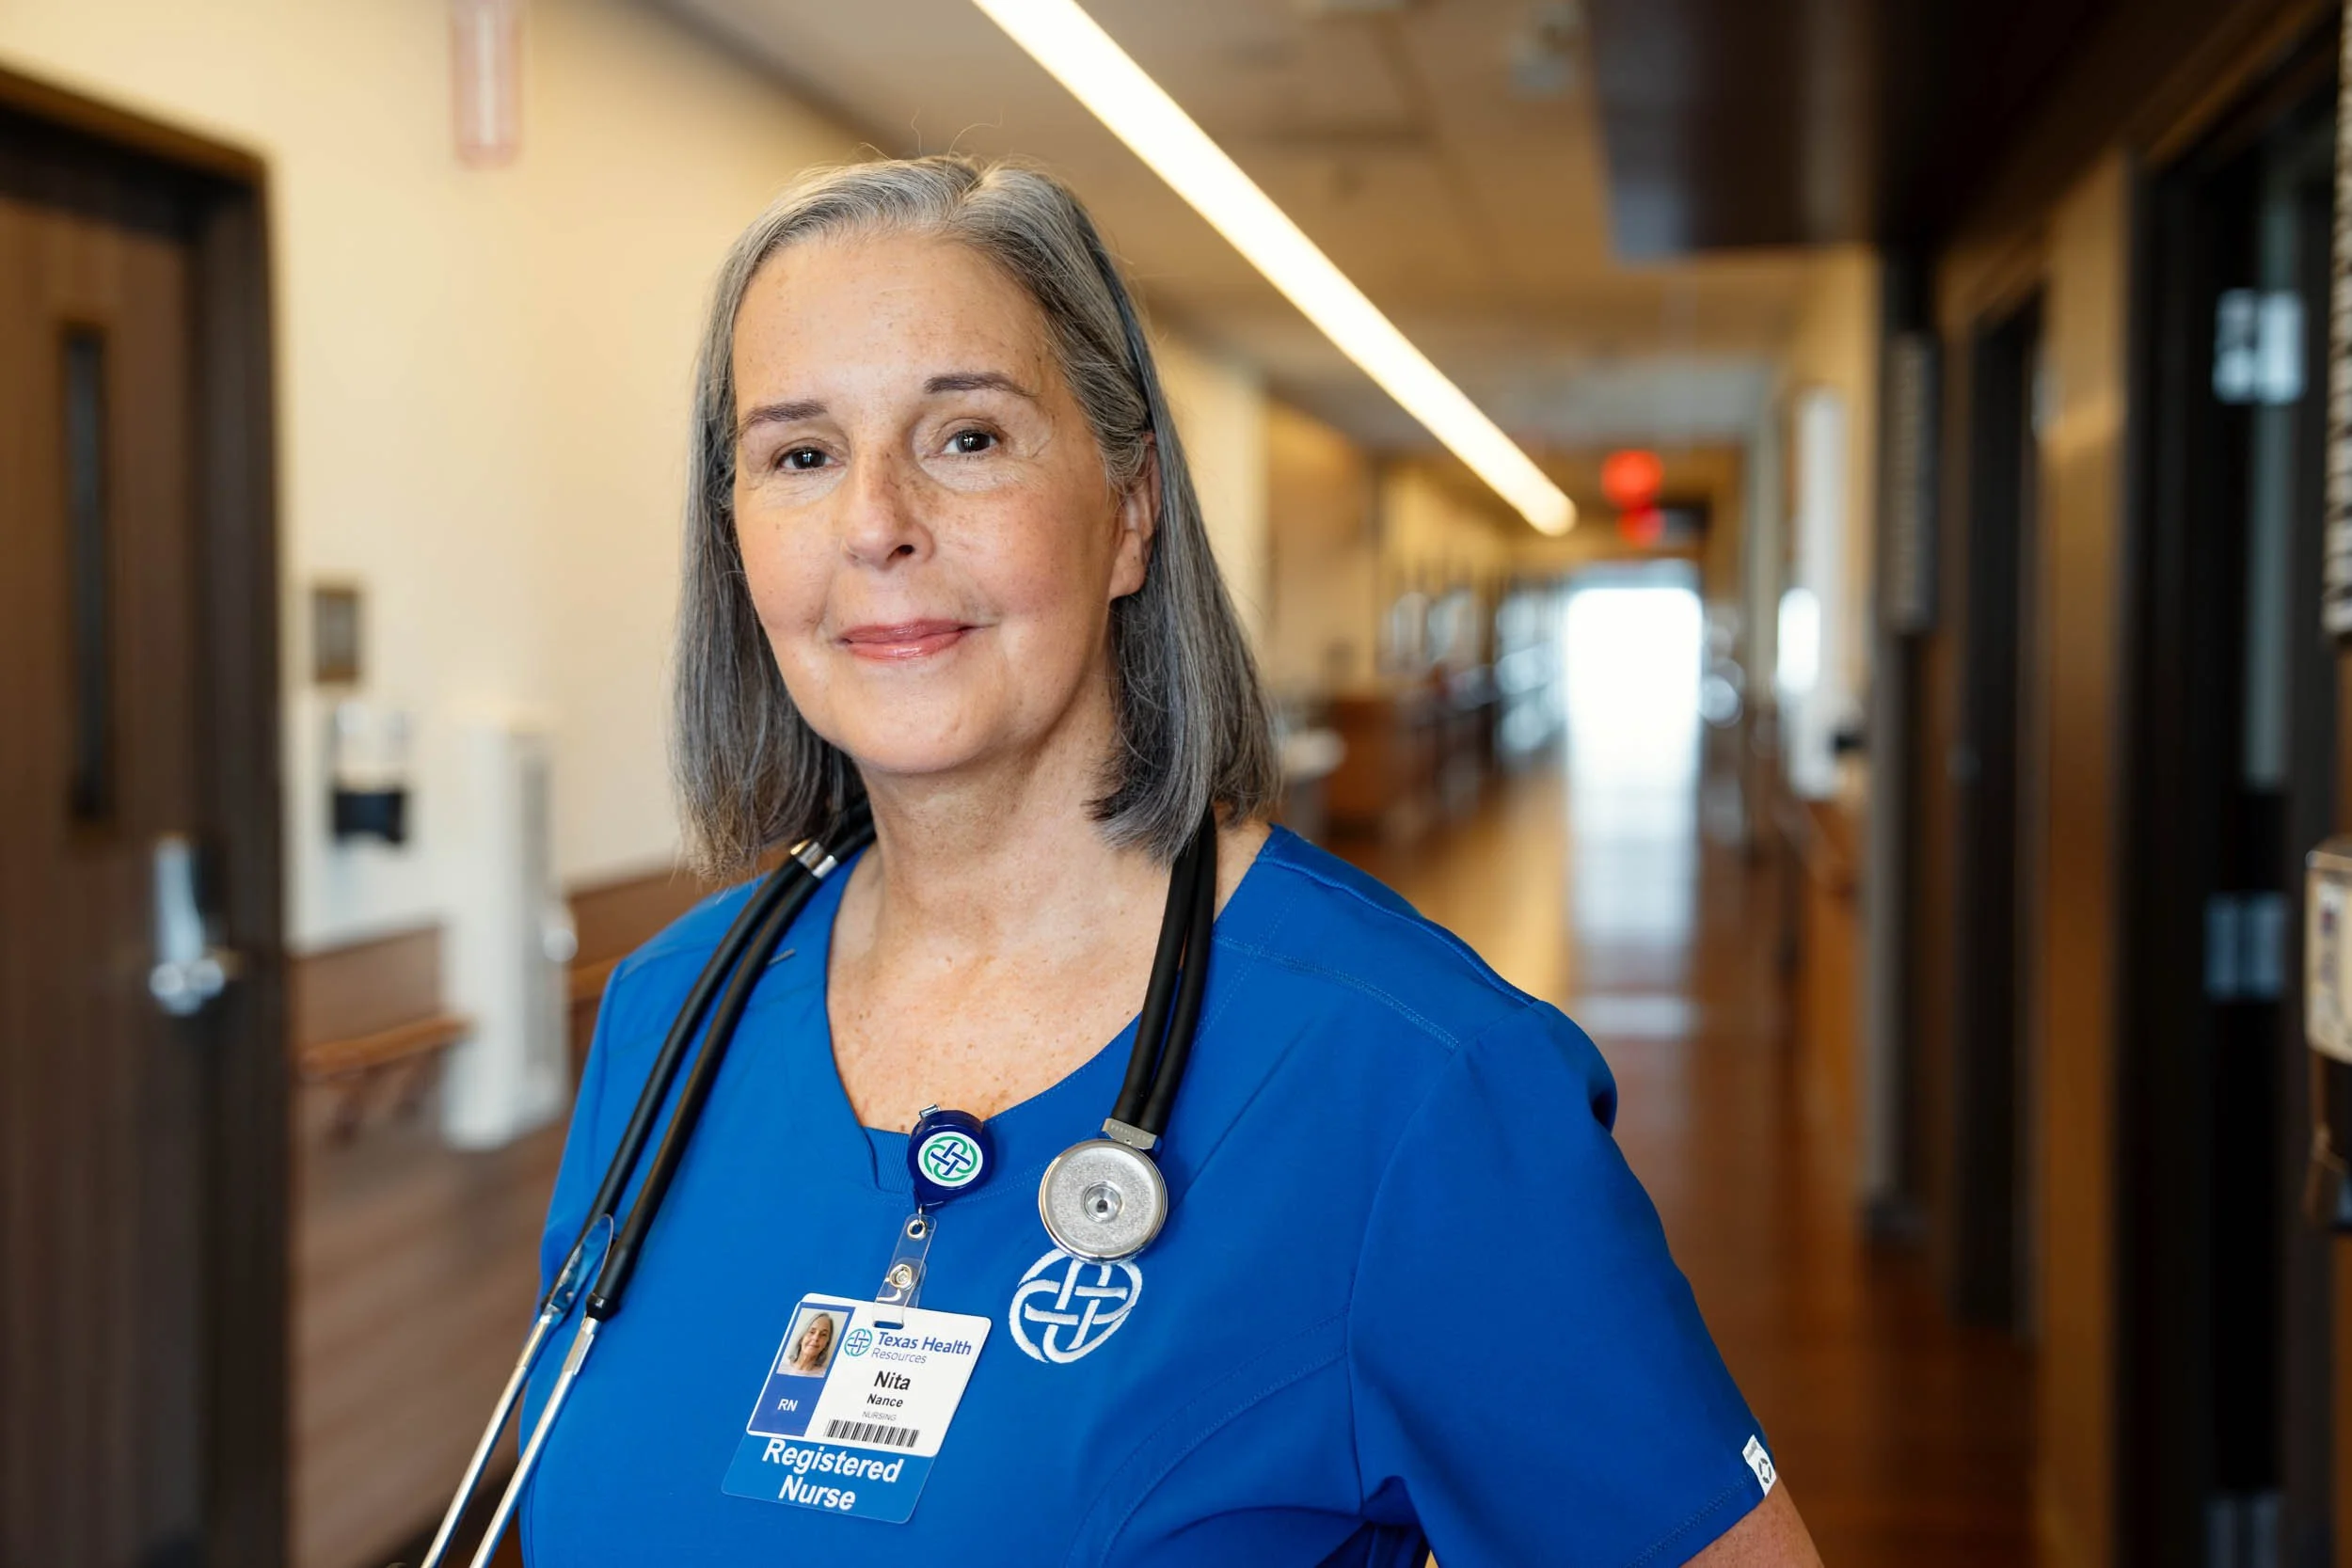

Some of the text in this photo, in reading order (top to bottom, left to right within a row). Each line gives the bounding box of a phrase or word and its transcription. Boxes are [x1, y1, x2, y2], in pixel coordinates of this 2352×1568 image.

[878, 1331, 972, 1355] Texas Health
[871, 1348, 927, 1364] Resources
[874, 1370, 912, 1390] Nita
[777, 1399, 798, 1412] RN
[866, 1393, 903, 1408] Nance
[862, 1411, 897, 1421] NURSING
[762, 1438, 904, 1482] Registered
[778, 1475, 856, 1511] Nurse
